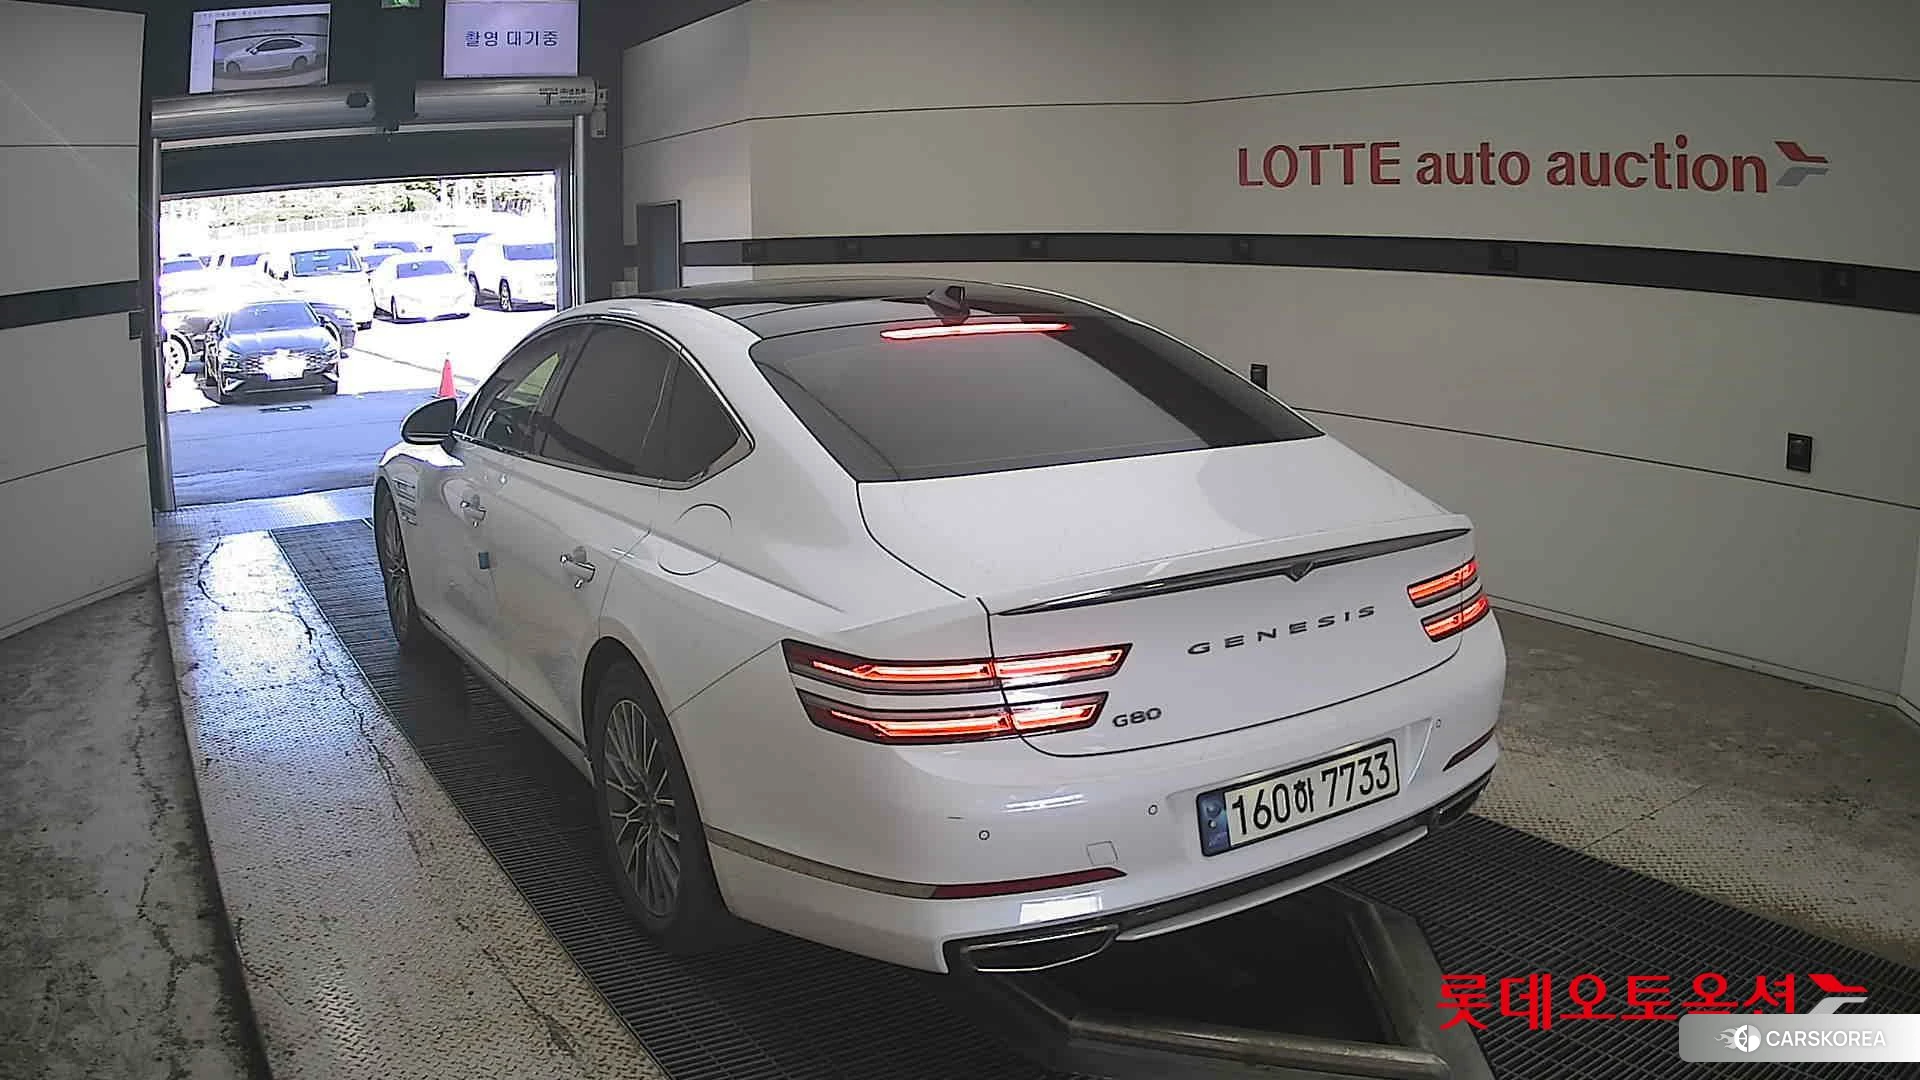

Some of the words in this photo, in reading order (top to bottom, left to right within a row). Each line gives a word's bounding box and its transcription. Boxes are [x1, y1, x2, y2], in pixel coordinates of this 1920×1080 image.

[506, 30, 558, 47] 대기중
[1238, 142, 1400, 187] LOTTE
[1416, 142, 1530, 185] auto
[1547, 135, 1768, 193] auction
[1187, 606, 1376, 654] GENESIS
[1112, 707, 1162, 728] G80
